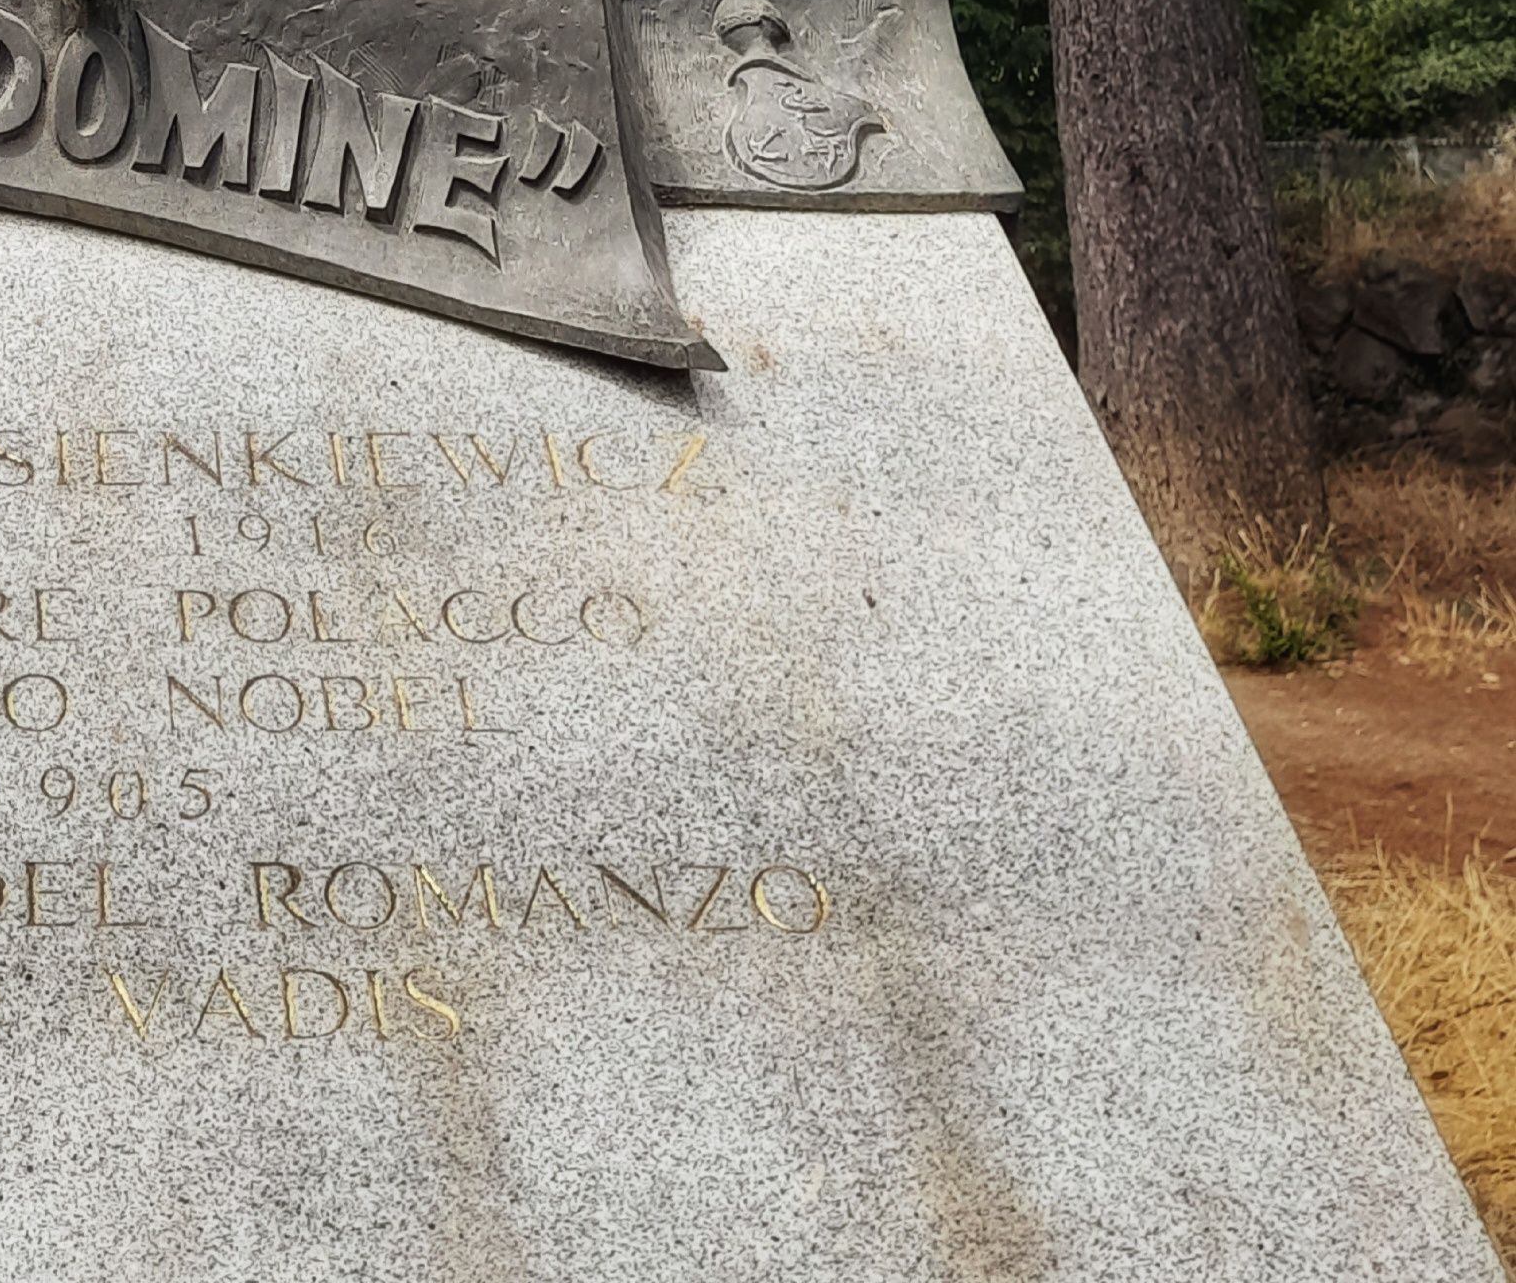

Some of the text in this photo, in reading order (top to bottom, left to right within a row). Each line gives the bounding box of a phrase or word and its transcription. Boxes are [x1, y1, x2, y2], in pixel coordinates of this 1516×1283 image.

[184, 513, 396, 557] 1916
[176, 589, 648, 645] POLACCO
[166, 674, 522, 734] NOBEL
[248, 861, 830, 935] ROMANZO
[102, 967, 462, 1039] VADIS
